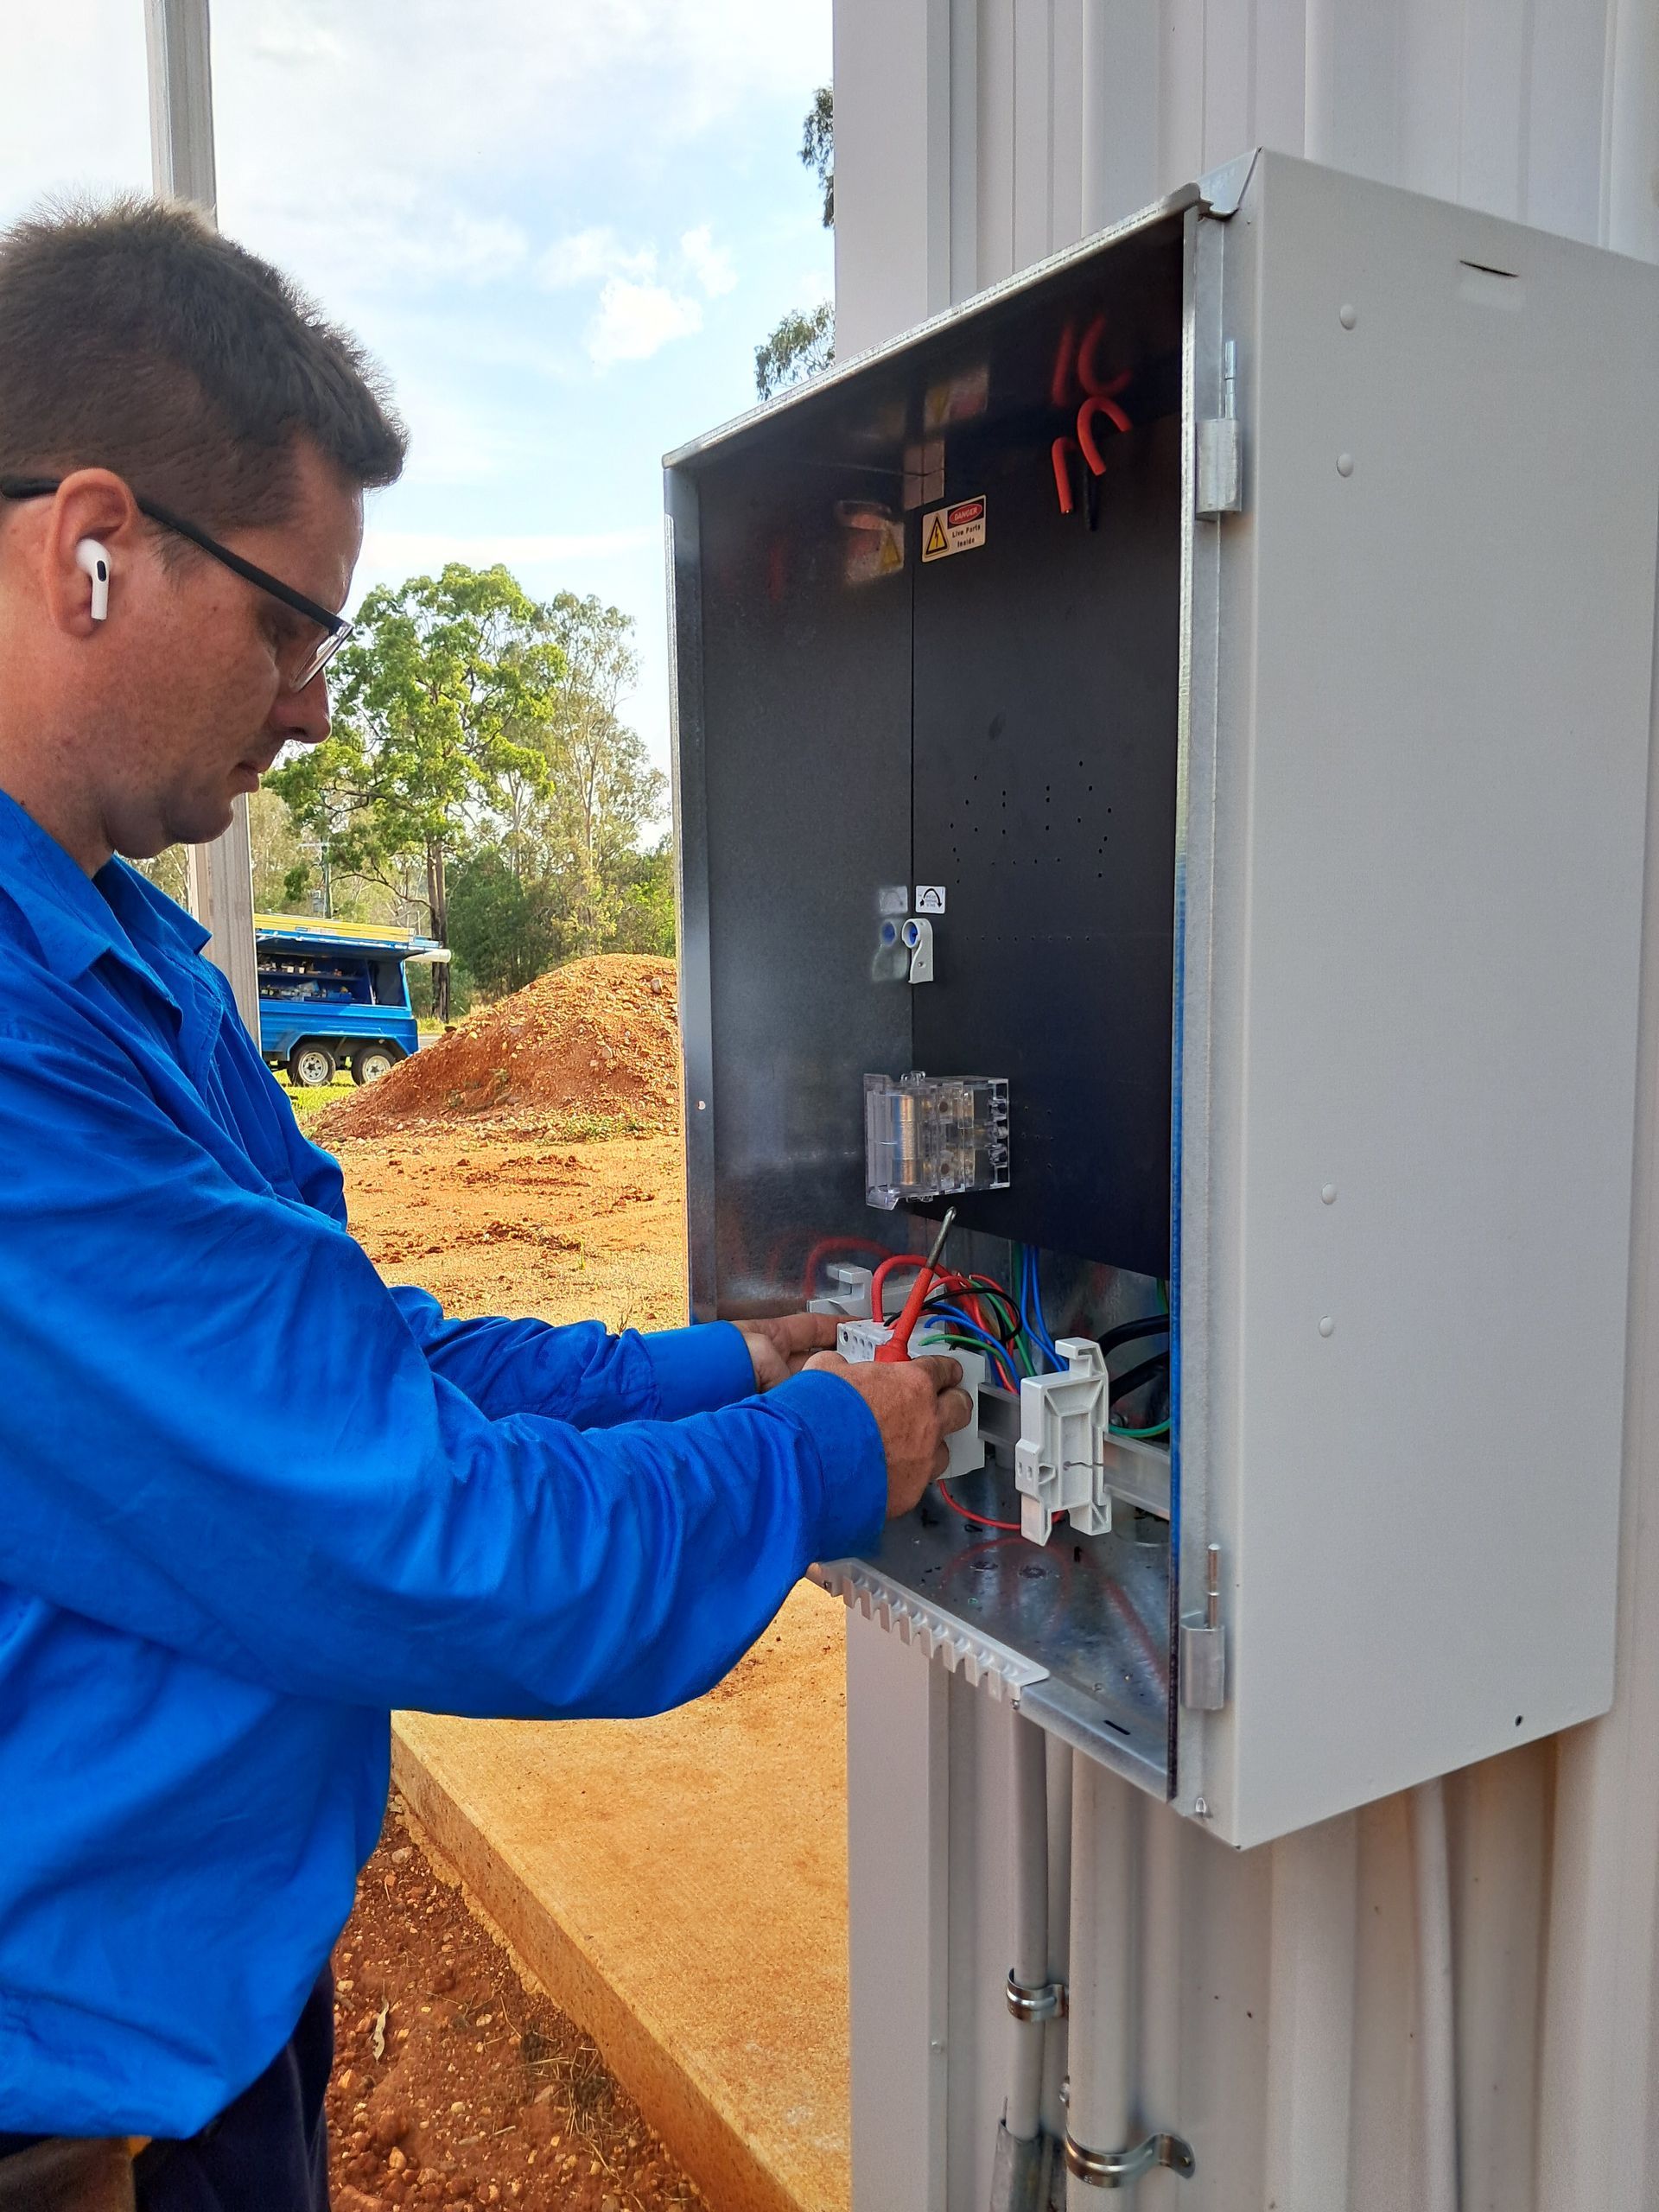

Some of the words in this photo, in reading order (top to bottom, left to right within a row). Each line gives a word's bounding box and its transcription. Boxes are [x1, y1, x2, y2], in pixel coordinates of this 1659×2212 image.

[954, 506, 978, 521] DANGER
[952, 530, 964, 538] Live
[965, 524, 981, 534] Parts
[957, 537, 975, 548] Inside
